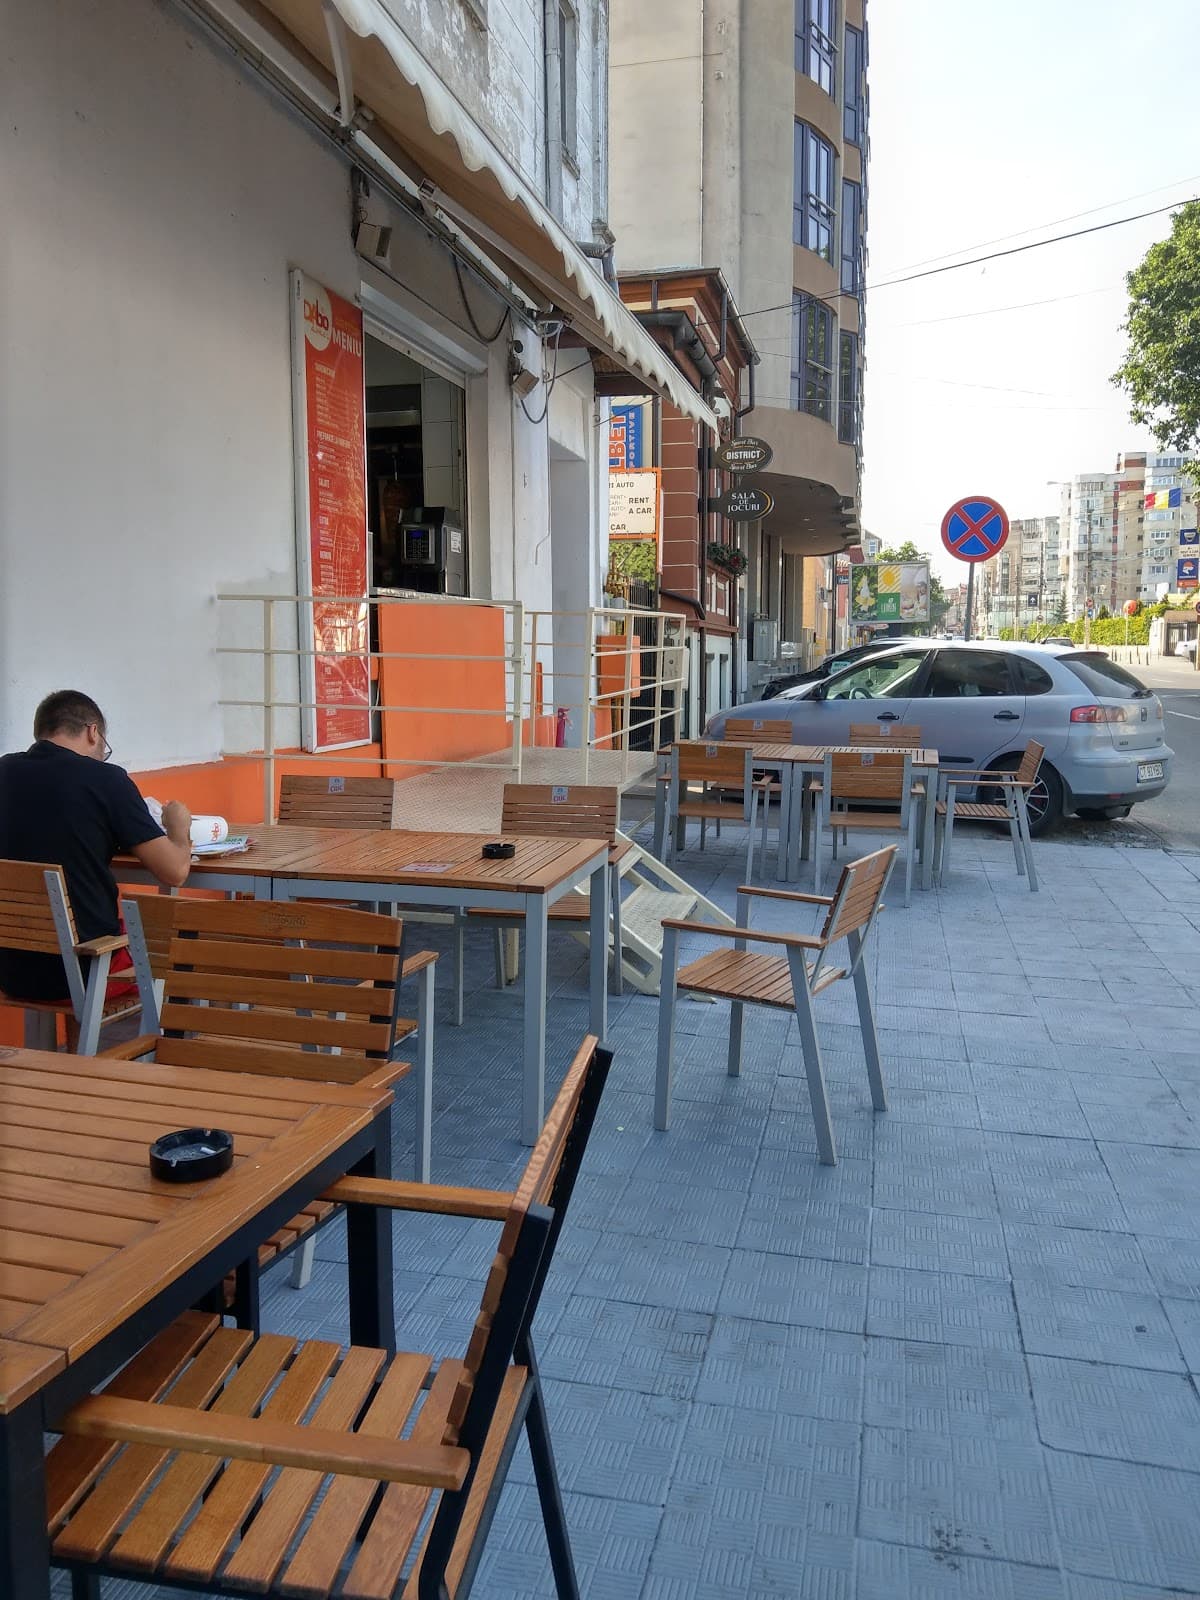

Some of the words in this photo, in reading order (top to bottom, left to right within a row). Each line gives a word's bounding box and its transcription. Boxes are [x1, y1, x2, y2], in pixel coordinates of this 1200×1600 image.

[332, 327, 361, 357] MENIU
[726, 450, 760, 460] DISTRICT
[727, 504, 760, 513] JOCURI
